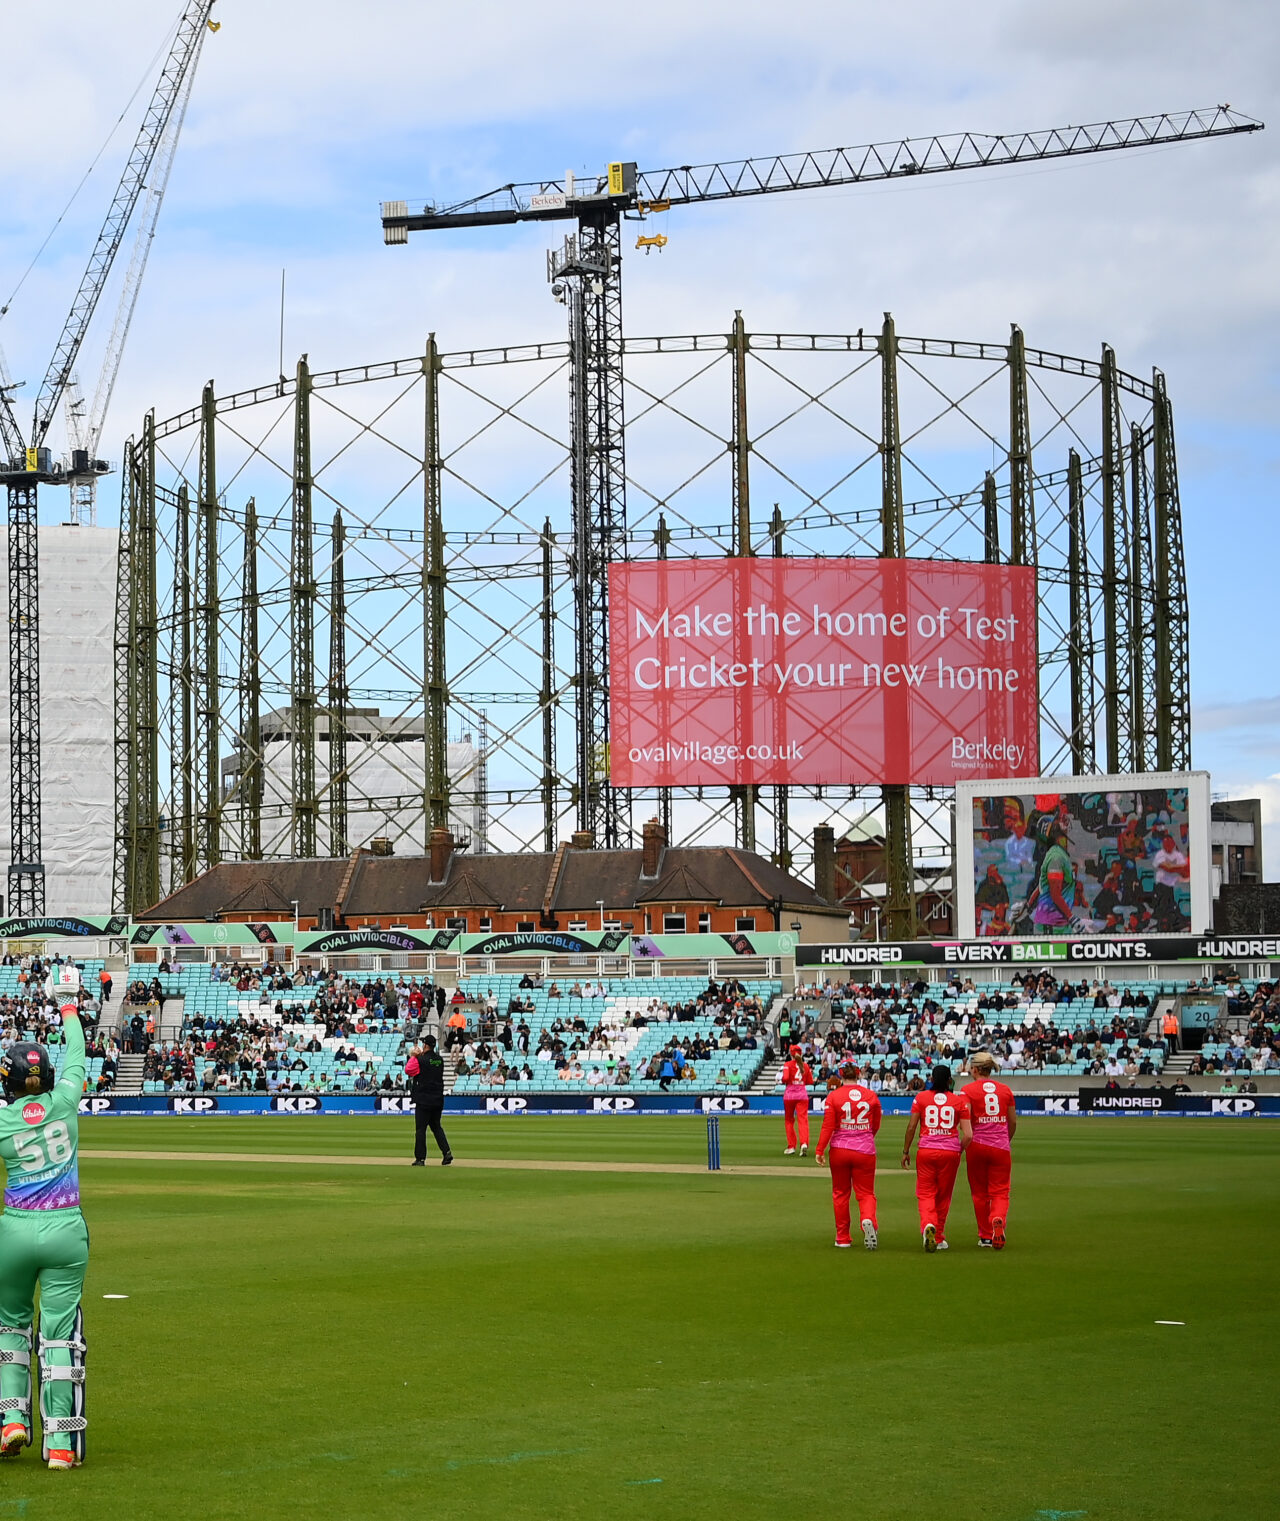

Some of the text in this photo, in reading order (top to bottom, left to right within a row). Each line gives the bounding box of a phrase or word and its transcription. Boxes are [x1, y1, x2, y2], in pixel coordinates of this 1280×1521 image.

[531, 196, 564, 206] Berkeley
[634, 603, 1019, 642] Make the home of Test
[634, 655, 1019, 693] Cricket your new home
[628, 739, 804, 765] ovalvillage.co.uk
[951, 735, 1025, 769] Berkeley
[26, 917, 89, 936] INVINCIBLES
[320, 931, 414, 952] OVAL INVINCIBLES
[483, 933, 581, 954] OVAL INVINCIBLES
[821, 946, 902, 963] HUNDRED
[944, 942, 1151, 961] EVERY. BALL. COUNTS.
[1195, 1011, 1210, 1022] 20
[175, 1098, 213, 1112] KP
[278, 1098, 317, 1112] KP
[487, 1098, 528, 1111] KP
[593, 1098, 634, 1111] KP
[702, 1098, 744, 1111] KP
[984, 1093, 1000, 1116] 8
[1092, 1097, 1162, 1107] HUNDRED
[1212, 1100, 1255, 1112] KP
[22, 1107, 46, 1119] Vitality
[840, 1101, 871, 1124] 12
[924, 1105, 955, 1129] 89
[12, 1120, 73, 1172] 58
